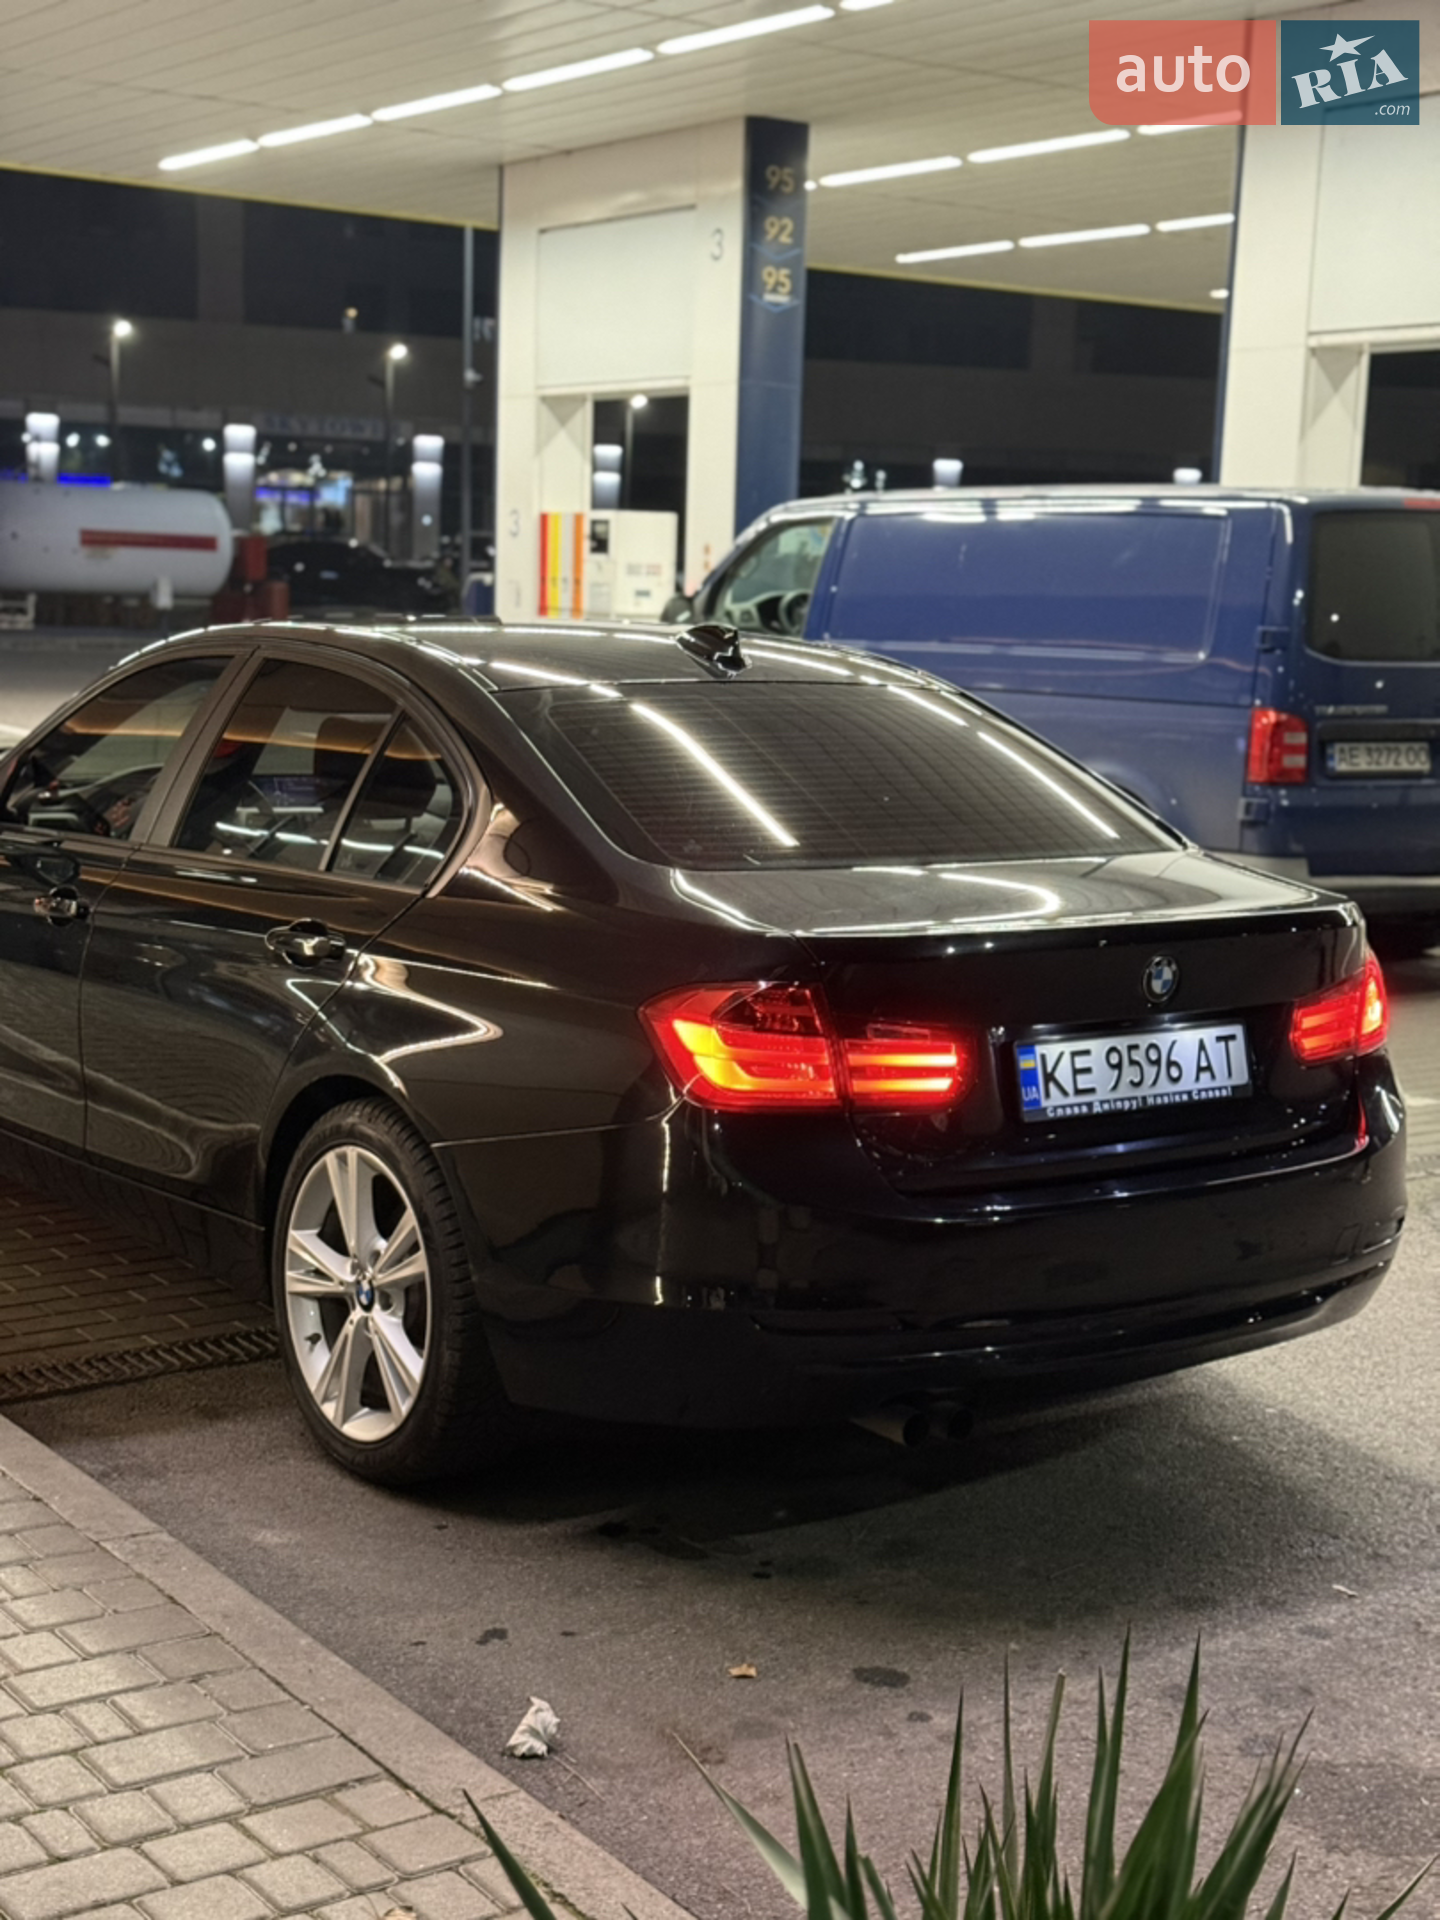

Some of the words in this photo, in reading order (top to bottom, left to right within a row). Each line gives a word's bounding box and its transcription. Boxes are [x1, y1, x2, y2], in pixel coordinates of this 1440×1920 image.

[765, 164, 795, 193] 95
[710, 227, 724, 262] 3
[764, 216, 794, 244] 92
[761, 265, 792, 294] 95
[1337, 746, 1360, 767] AE
[1040, 1048, 1097, 1100] KE
[1104, 1039, 1183, 1093] 9596
[1194, 1033, 1237, 1083] AT
[1021, 1085, 1040, 1102] UA
